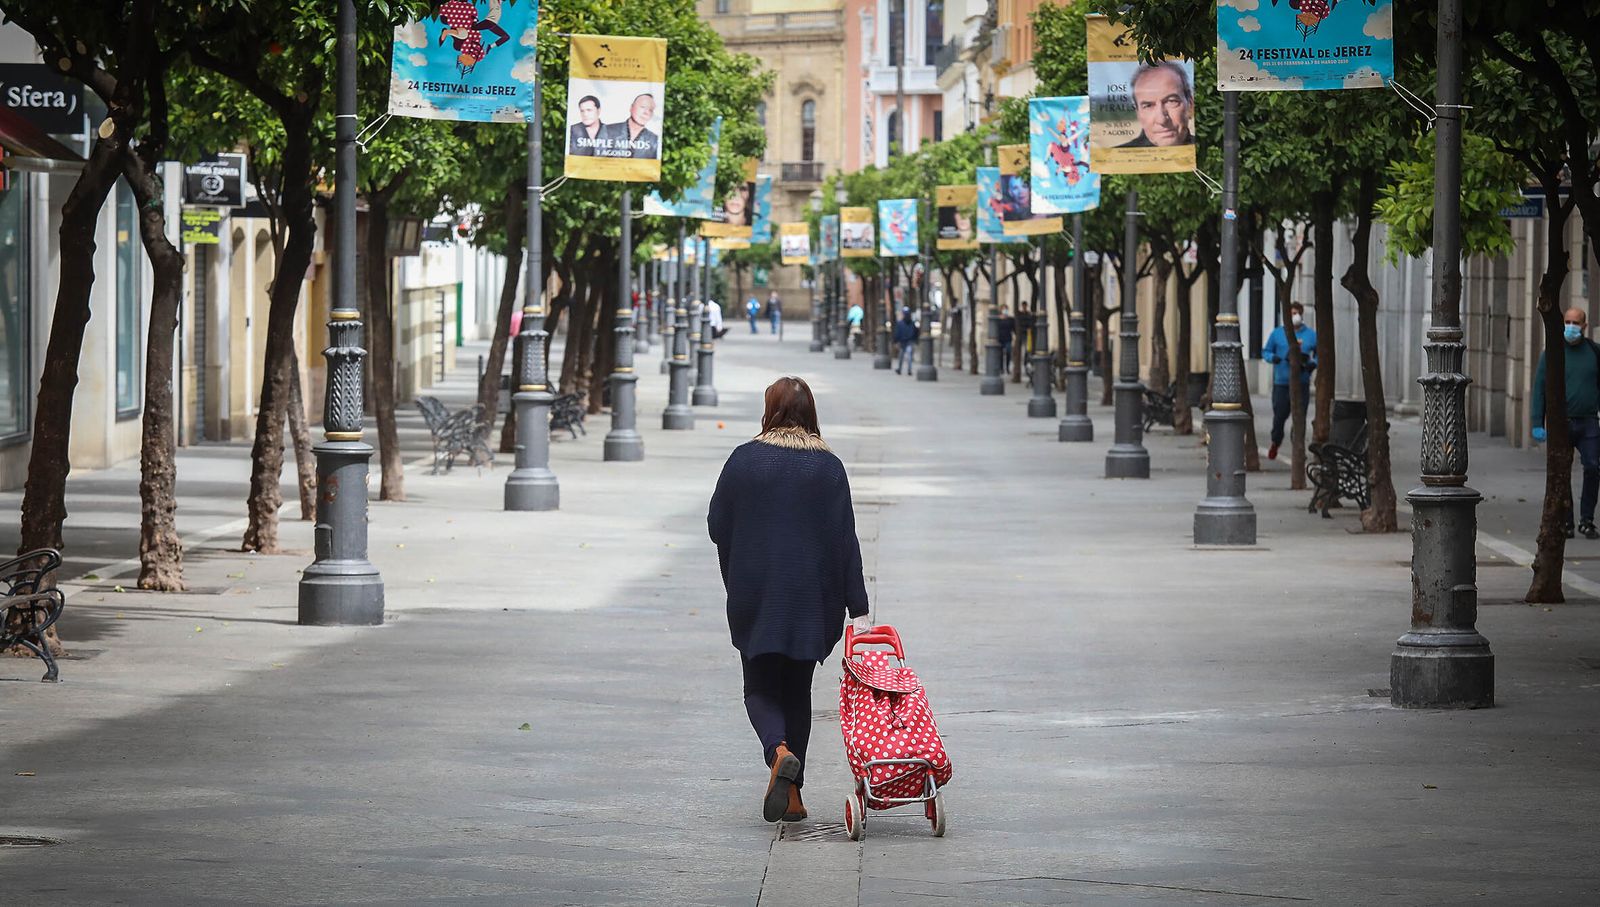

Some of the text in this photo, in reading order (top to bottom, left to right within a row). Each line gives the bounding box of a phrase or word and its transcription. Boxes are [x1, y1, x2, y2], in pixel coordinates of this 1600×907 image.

[1239, 45, 1372, 60] 24 FESTIVAL DE JEREZ
[408, 80, 419, 91] 24
[422, 81, 470, 94] FESTIVAL
[472, 86, 483, 95] DE
[485, 85, 517, 96] JEREZ
[1107, 82, 1128, 92] JOSÉ
[1107, 94, 1128, 103] LUIS
[576, 137, 651, 150] SIMPLE MINDS
[602, 149, 632, 157] AGOSTO
